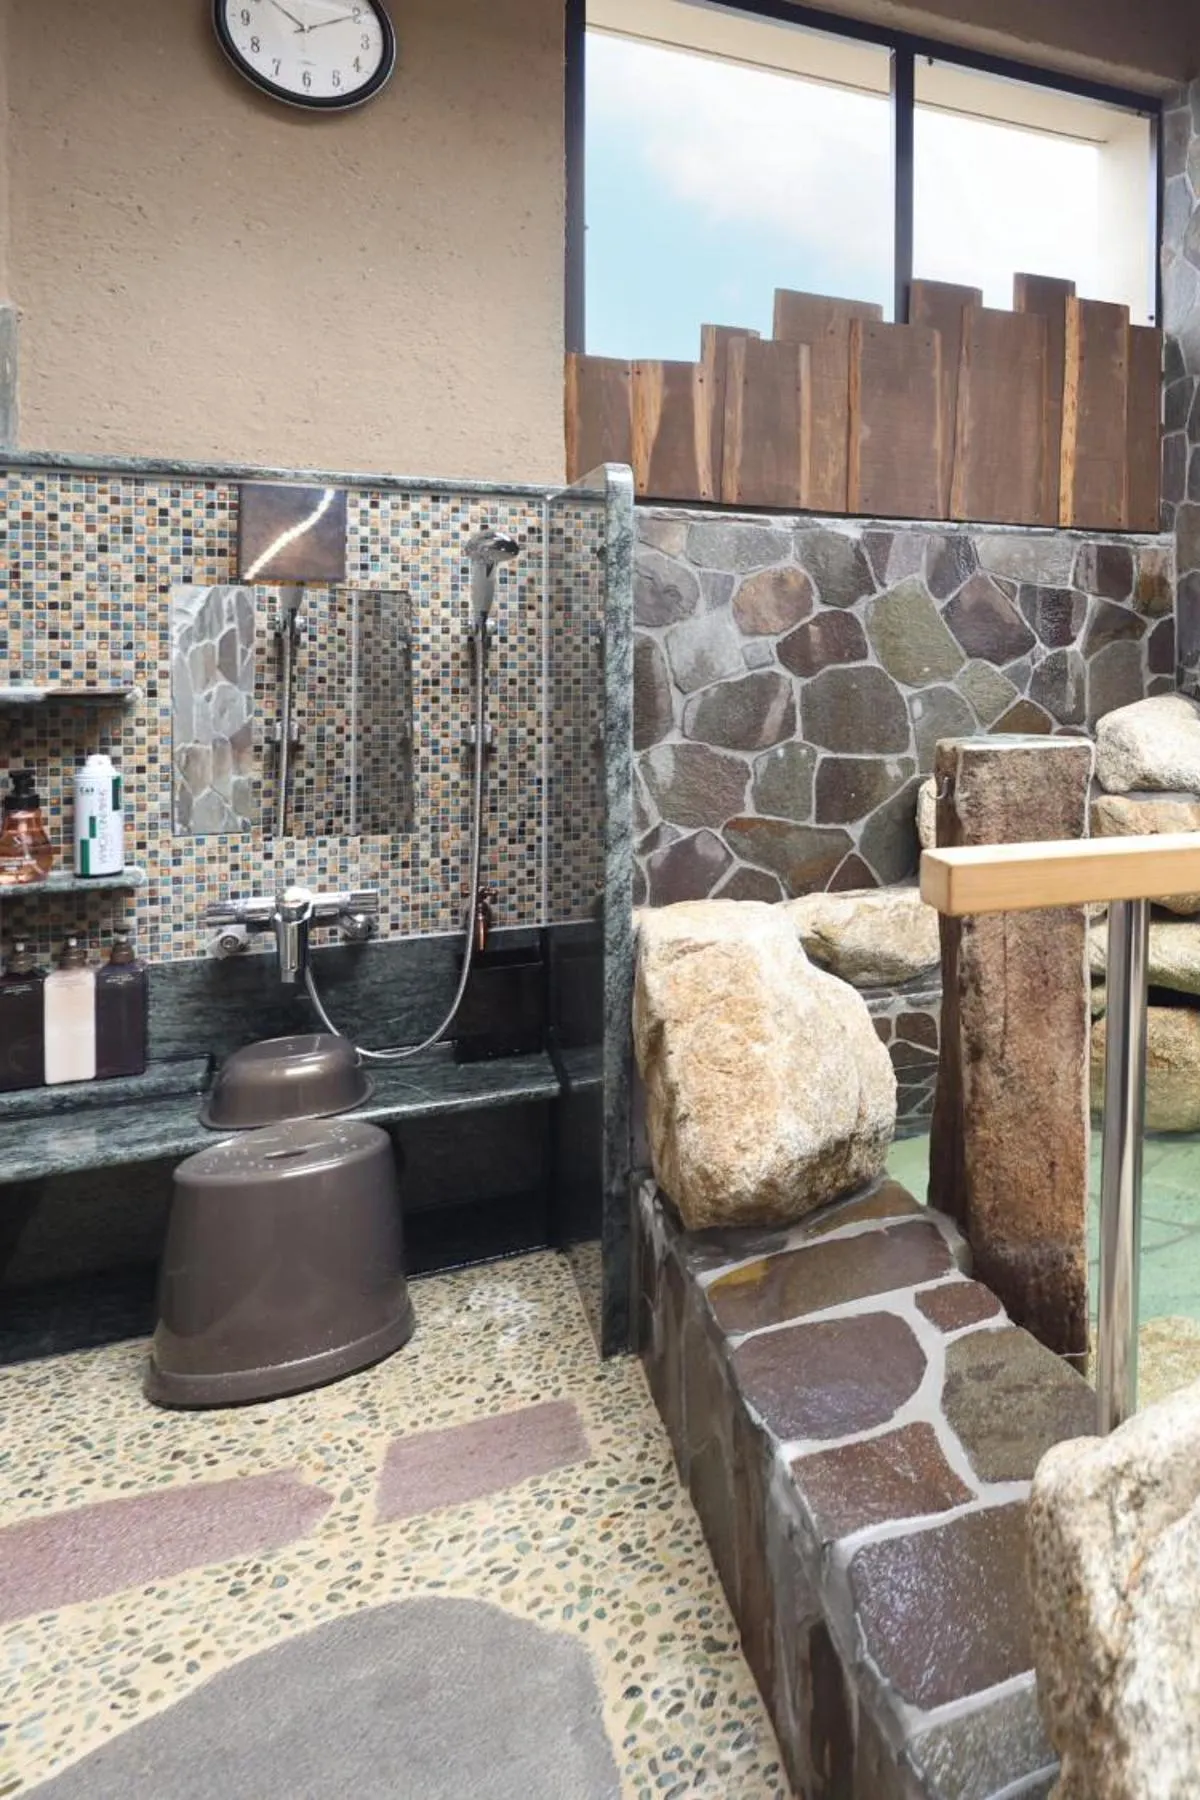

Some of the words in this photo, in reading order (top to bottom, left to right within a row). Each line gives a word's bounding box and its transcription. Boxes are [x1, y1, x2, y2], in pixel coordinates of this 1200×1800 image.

[241, 9, 250, 26] 9
[250, 37, 260, 53] 8
[361, 35, 370, 50] 3
[272, 59, 282, 76] 7
[353, 56, 362, 72] 4
[302, 72, 312, 88] 6
[332, 70, 341, 87] 5
